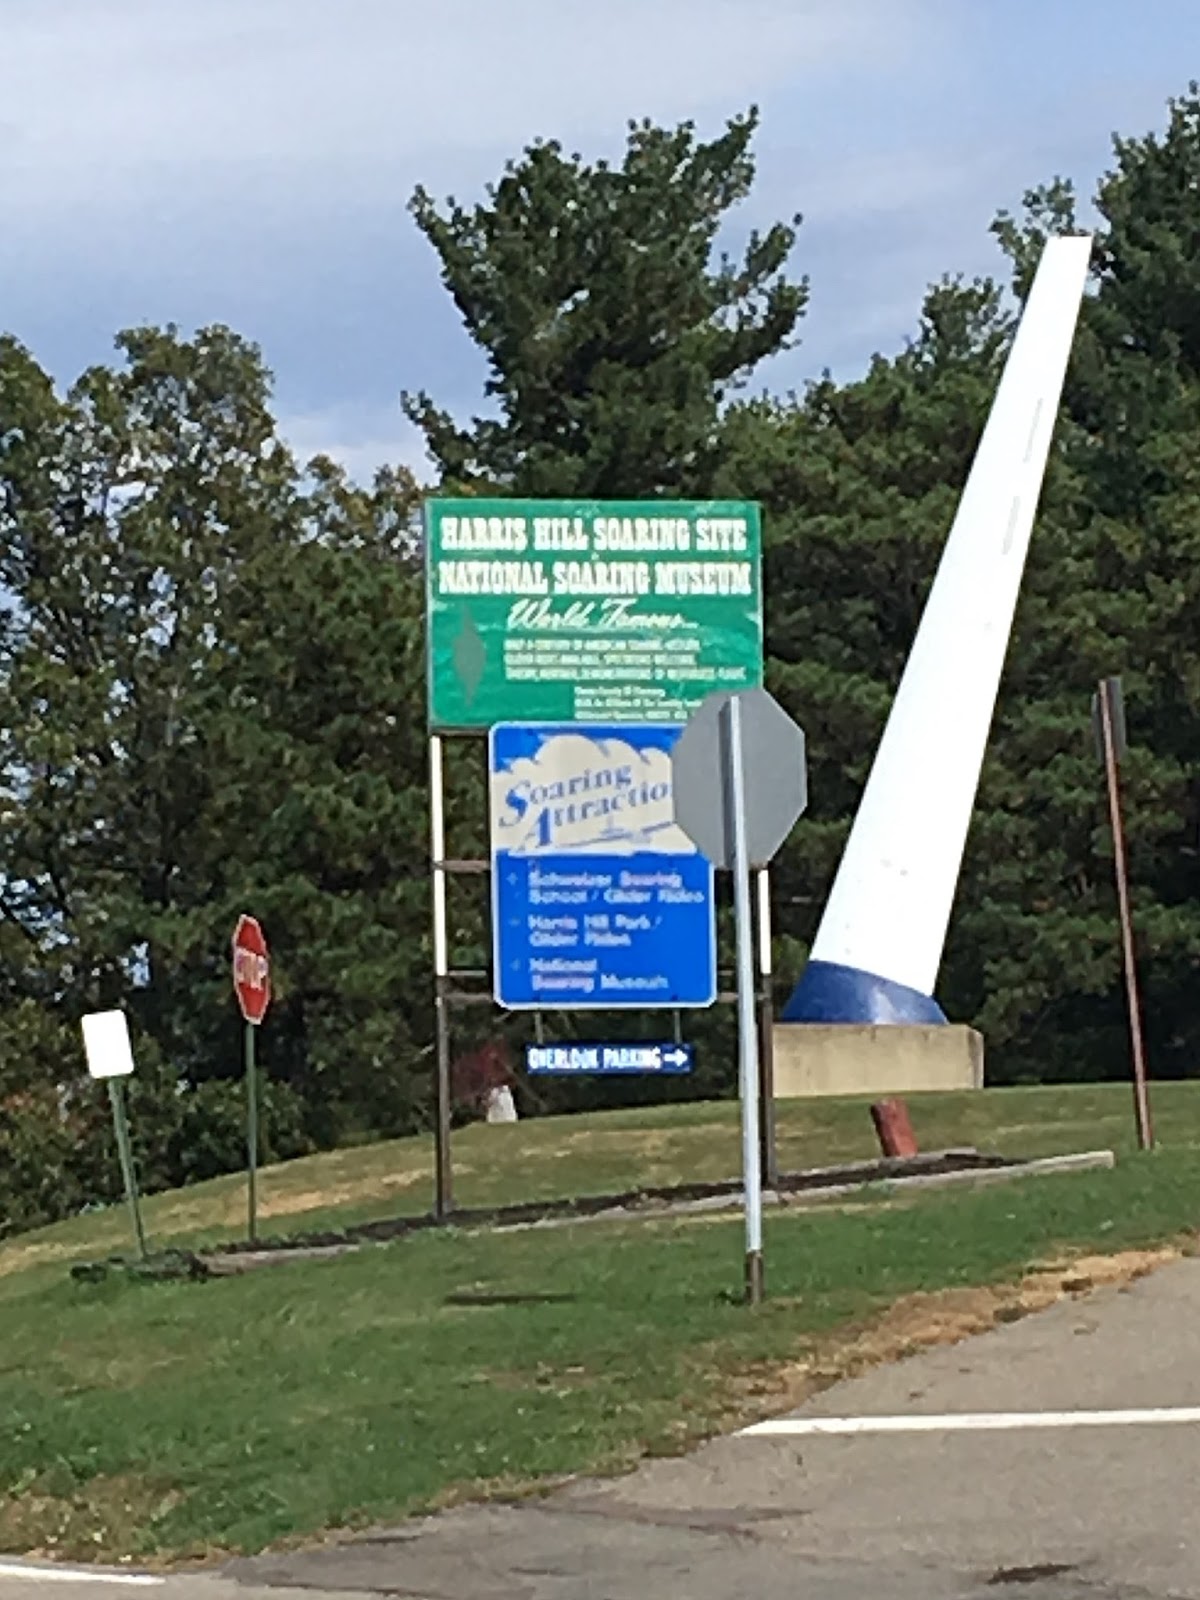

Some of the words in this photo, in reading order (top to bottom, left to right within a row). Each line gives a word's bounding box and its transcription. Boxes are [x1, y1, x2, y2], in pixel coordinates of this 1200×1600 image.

[441, 517, 527, 550] HARRIS
[534, 517, 588, 550] HILL
[594, 517, 690, 550] SOARING
[696, 518, 747, 550] SITE
[438, 561, 548, 594] NATIONAL
[553, 561, 650, 594] SOARING
[655, 562, 752, 595] MUSEUM
[506, 597, 595, 630] World
[499, 764, 633, 827] Soaring
[518, 782, 671, 852] Attractio
[528, 914, 578, 929] Harris
[615, 914, 651, 929] Park
[235, 946, 269, 991] STOP
[529, 958, 597, 972] National
[601, 974, 669, 989] Museum
[528, 1048, 599, 1070] OVERLOOK
[603, 1046, 661, 1069] PARKING
